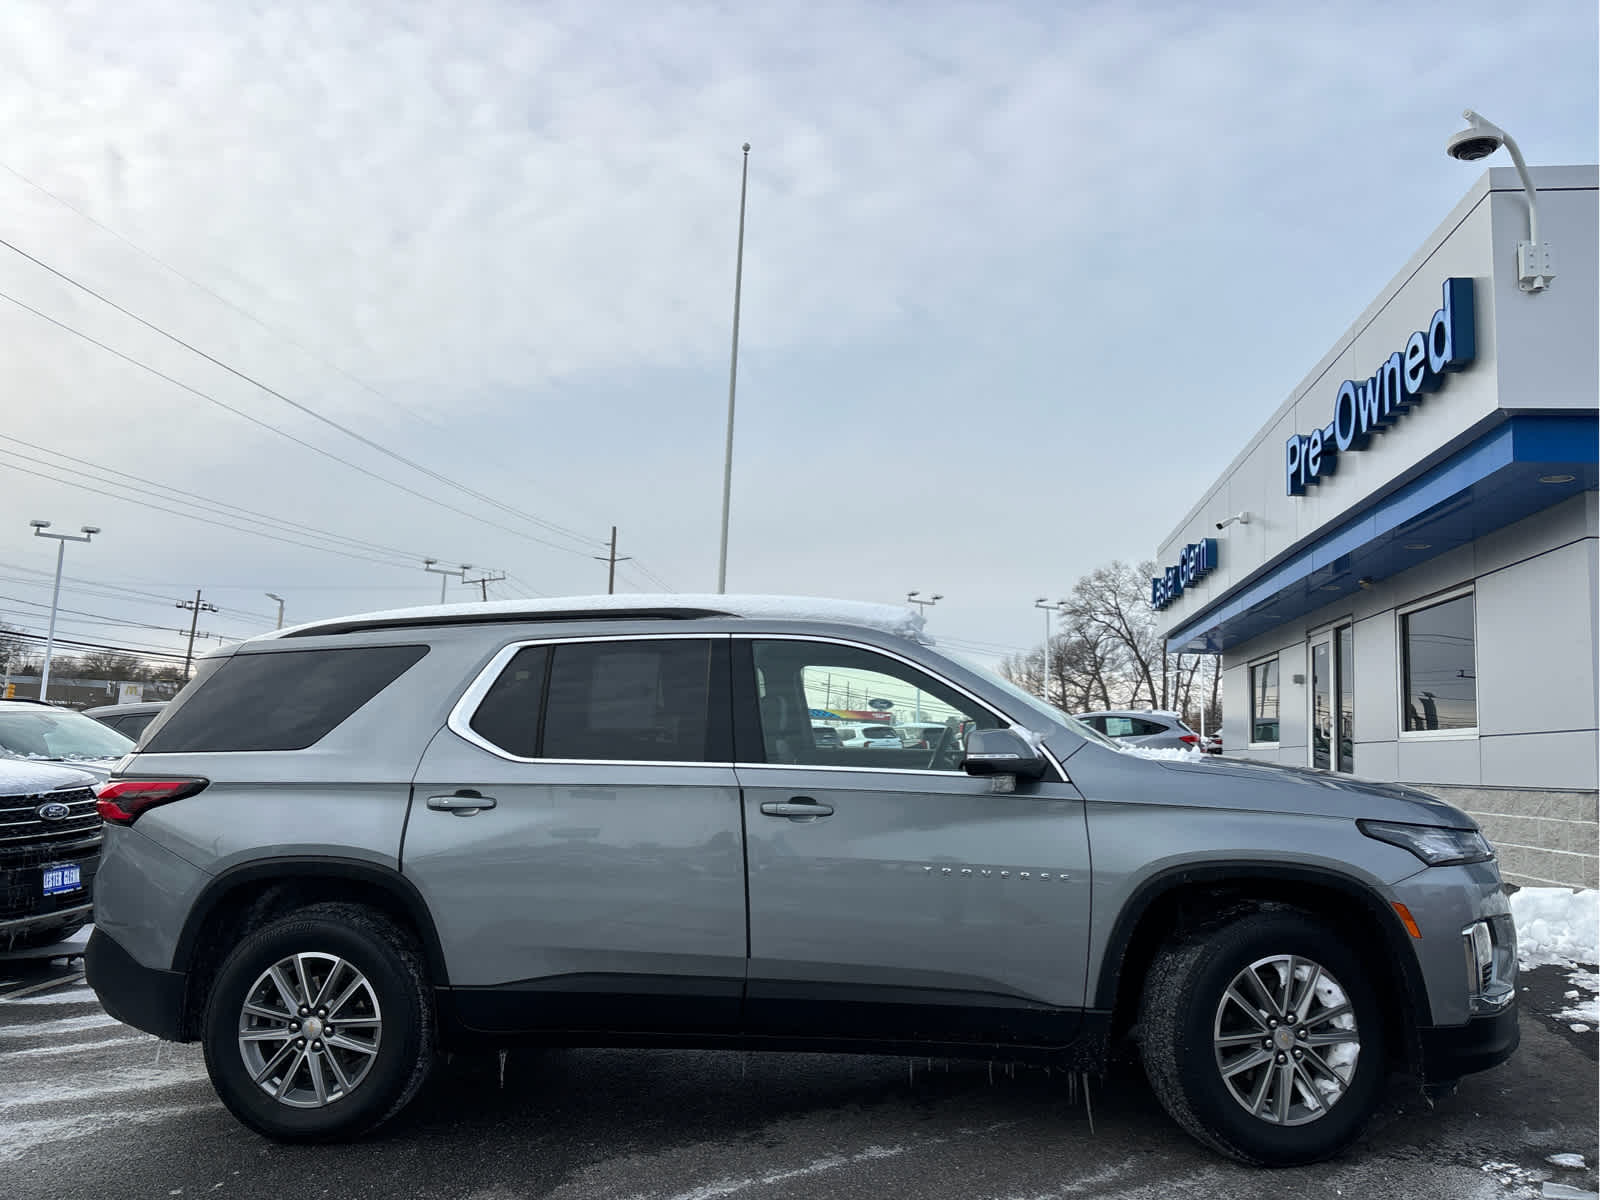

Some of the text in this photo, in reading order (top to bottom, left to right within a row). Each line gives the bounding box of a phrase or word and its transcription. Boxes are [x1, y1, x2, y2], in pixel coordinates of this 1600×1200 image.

[1286, 277, 1475, 497] Pre-Owned
[1179, 538, 1216, 597] Glenn
[43, 867, 80, 889] LESTER GLENN
[922, 865, 1071, 883] TRAVERSE
